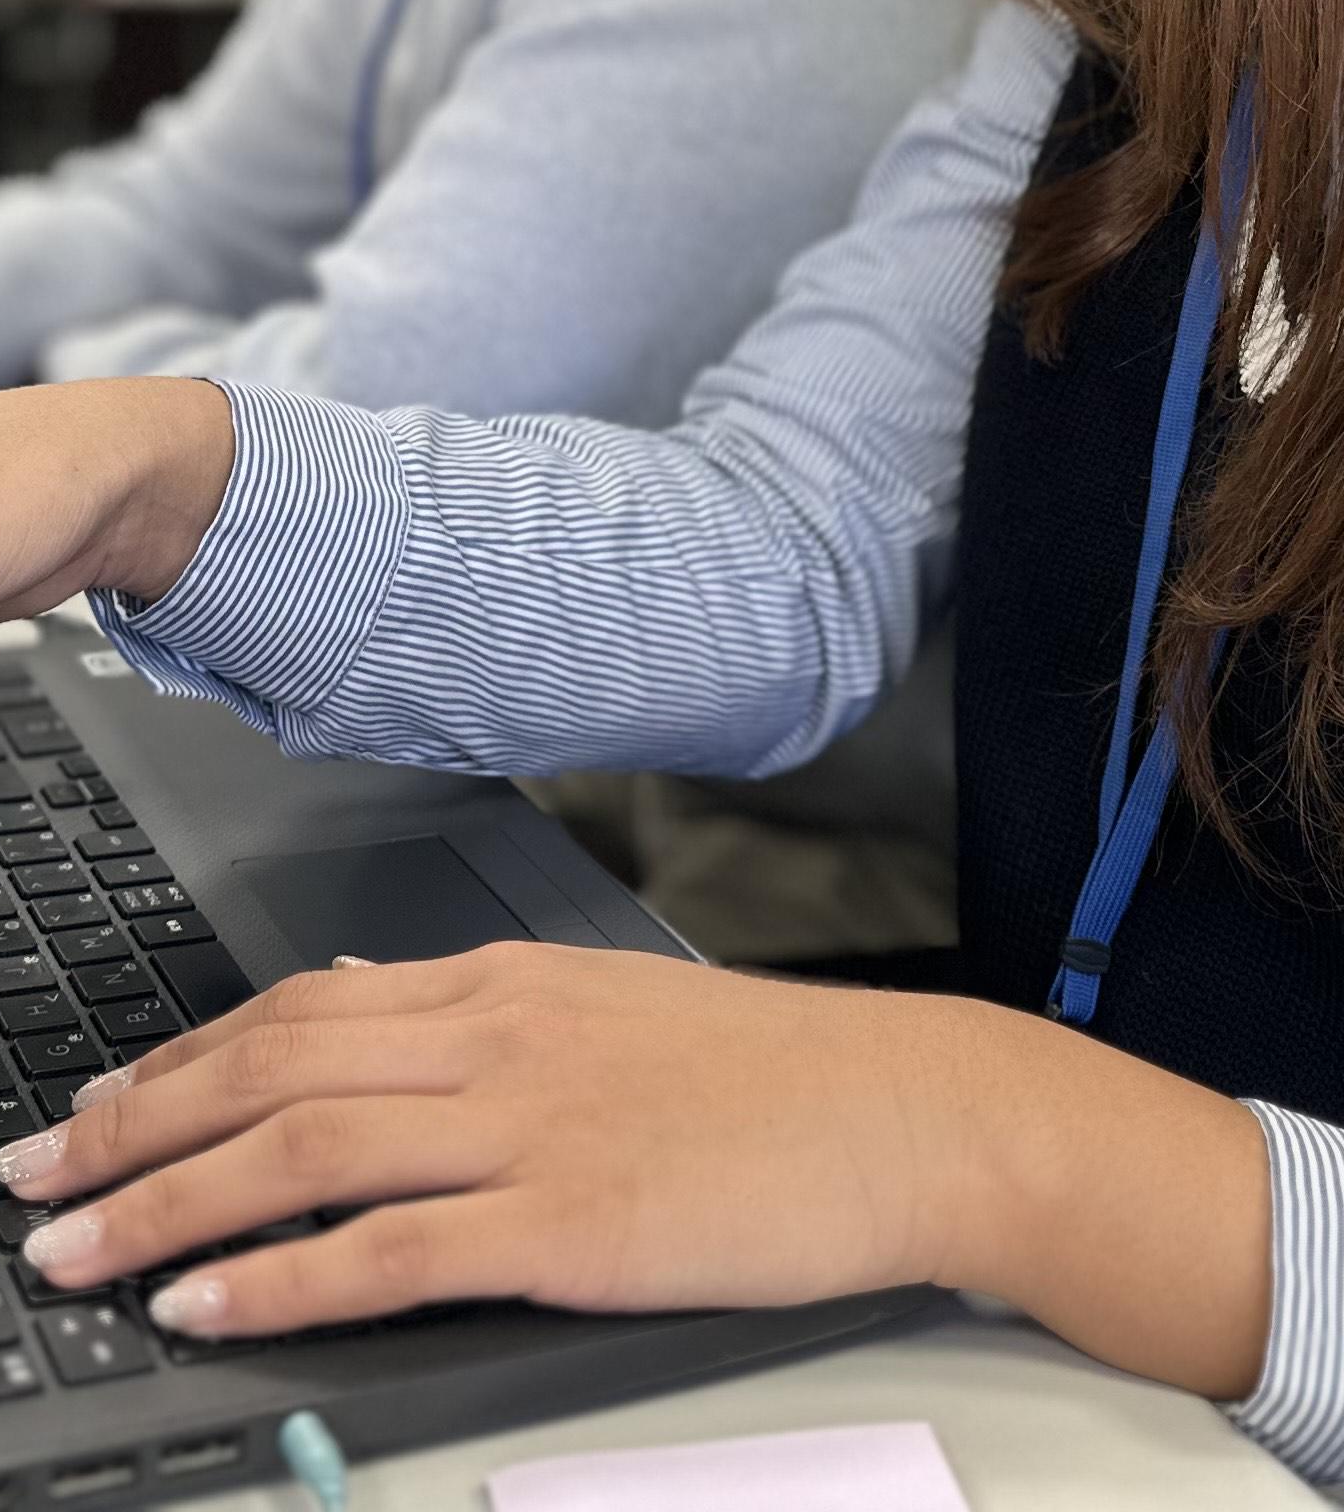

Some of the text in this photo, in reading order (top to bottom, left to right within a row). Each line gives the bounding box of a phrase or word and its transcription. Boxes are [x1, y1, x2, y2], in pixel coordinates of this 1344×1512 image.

[81, 937, 103, 949] M
[102, 973, 125, 985] N
[24, 1004, 48, 1016] H
[126, 1012, 149, 1023] B
[47, 1044, 70, 1056] G
